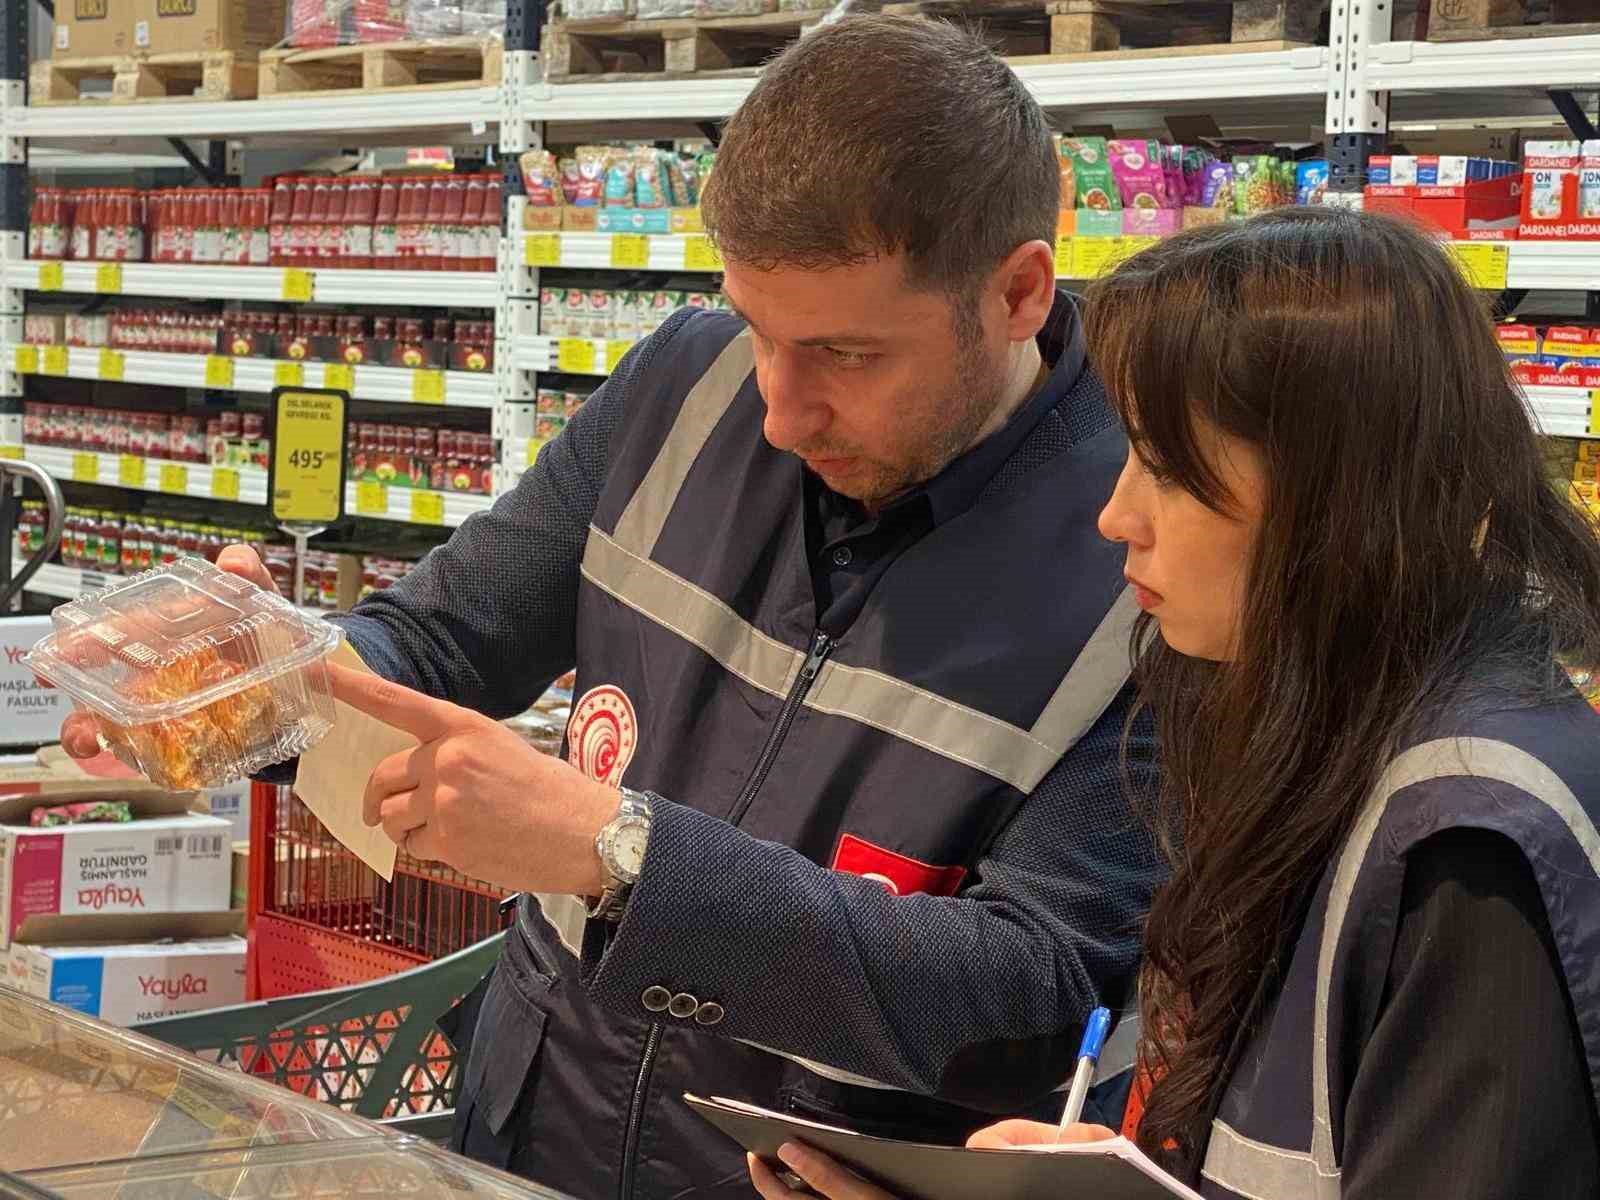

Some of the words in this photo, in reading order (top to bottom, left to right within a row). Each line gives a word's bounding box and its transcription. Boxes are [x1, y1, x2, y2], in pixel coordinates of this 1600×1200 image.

[1528, 159, 1570, 168] DARDANEL
[1371, 188, 1405, 196] DARDANEL
[1420, 188, 1456, 197] DARDANEL
[1469, 230, 1505, 240] DARDANEL
[1519, 224, 1568, 236] DARDANEL
[1538, 374, 1580, 385] DARDANEL
[288, 448, 323, 470] 495
[7, 696, 58, 707] FASULYE
[77, 883, 145, 911] Yayla
[137, 973, 208, 999] Yayla
